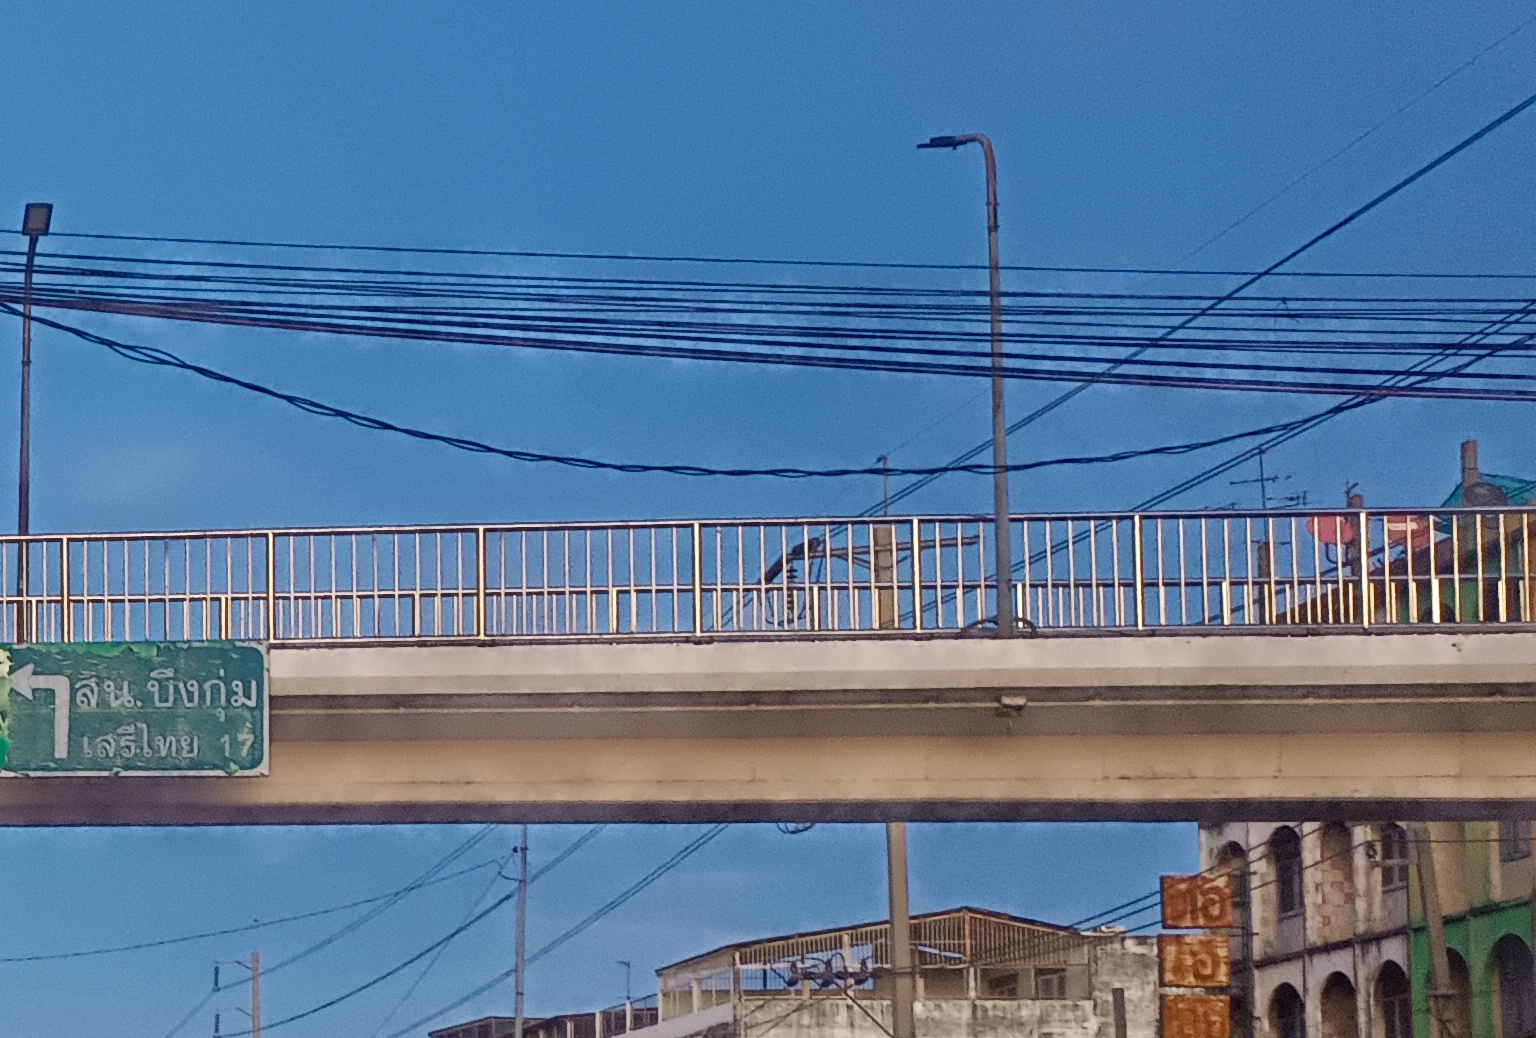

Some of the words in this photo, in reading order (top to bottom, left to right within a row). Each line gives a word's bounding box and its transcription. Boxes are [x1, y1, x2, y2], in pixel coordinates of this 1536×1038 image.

[74, 676, 143, 709] สน.
[147, 667, 257, 722] บึงกุ่ม
[82, 723, 199, 759] เสรีไทย
[220, 733, 256, 758] 17
